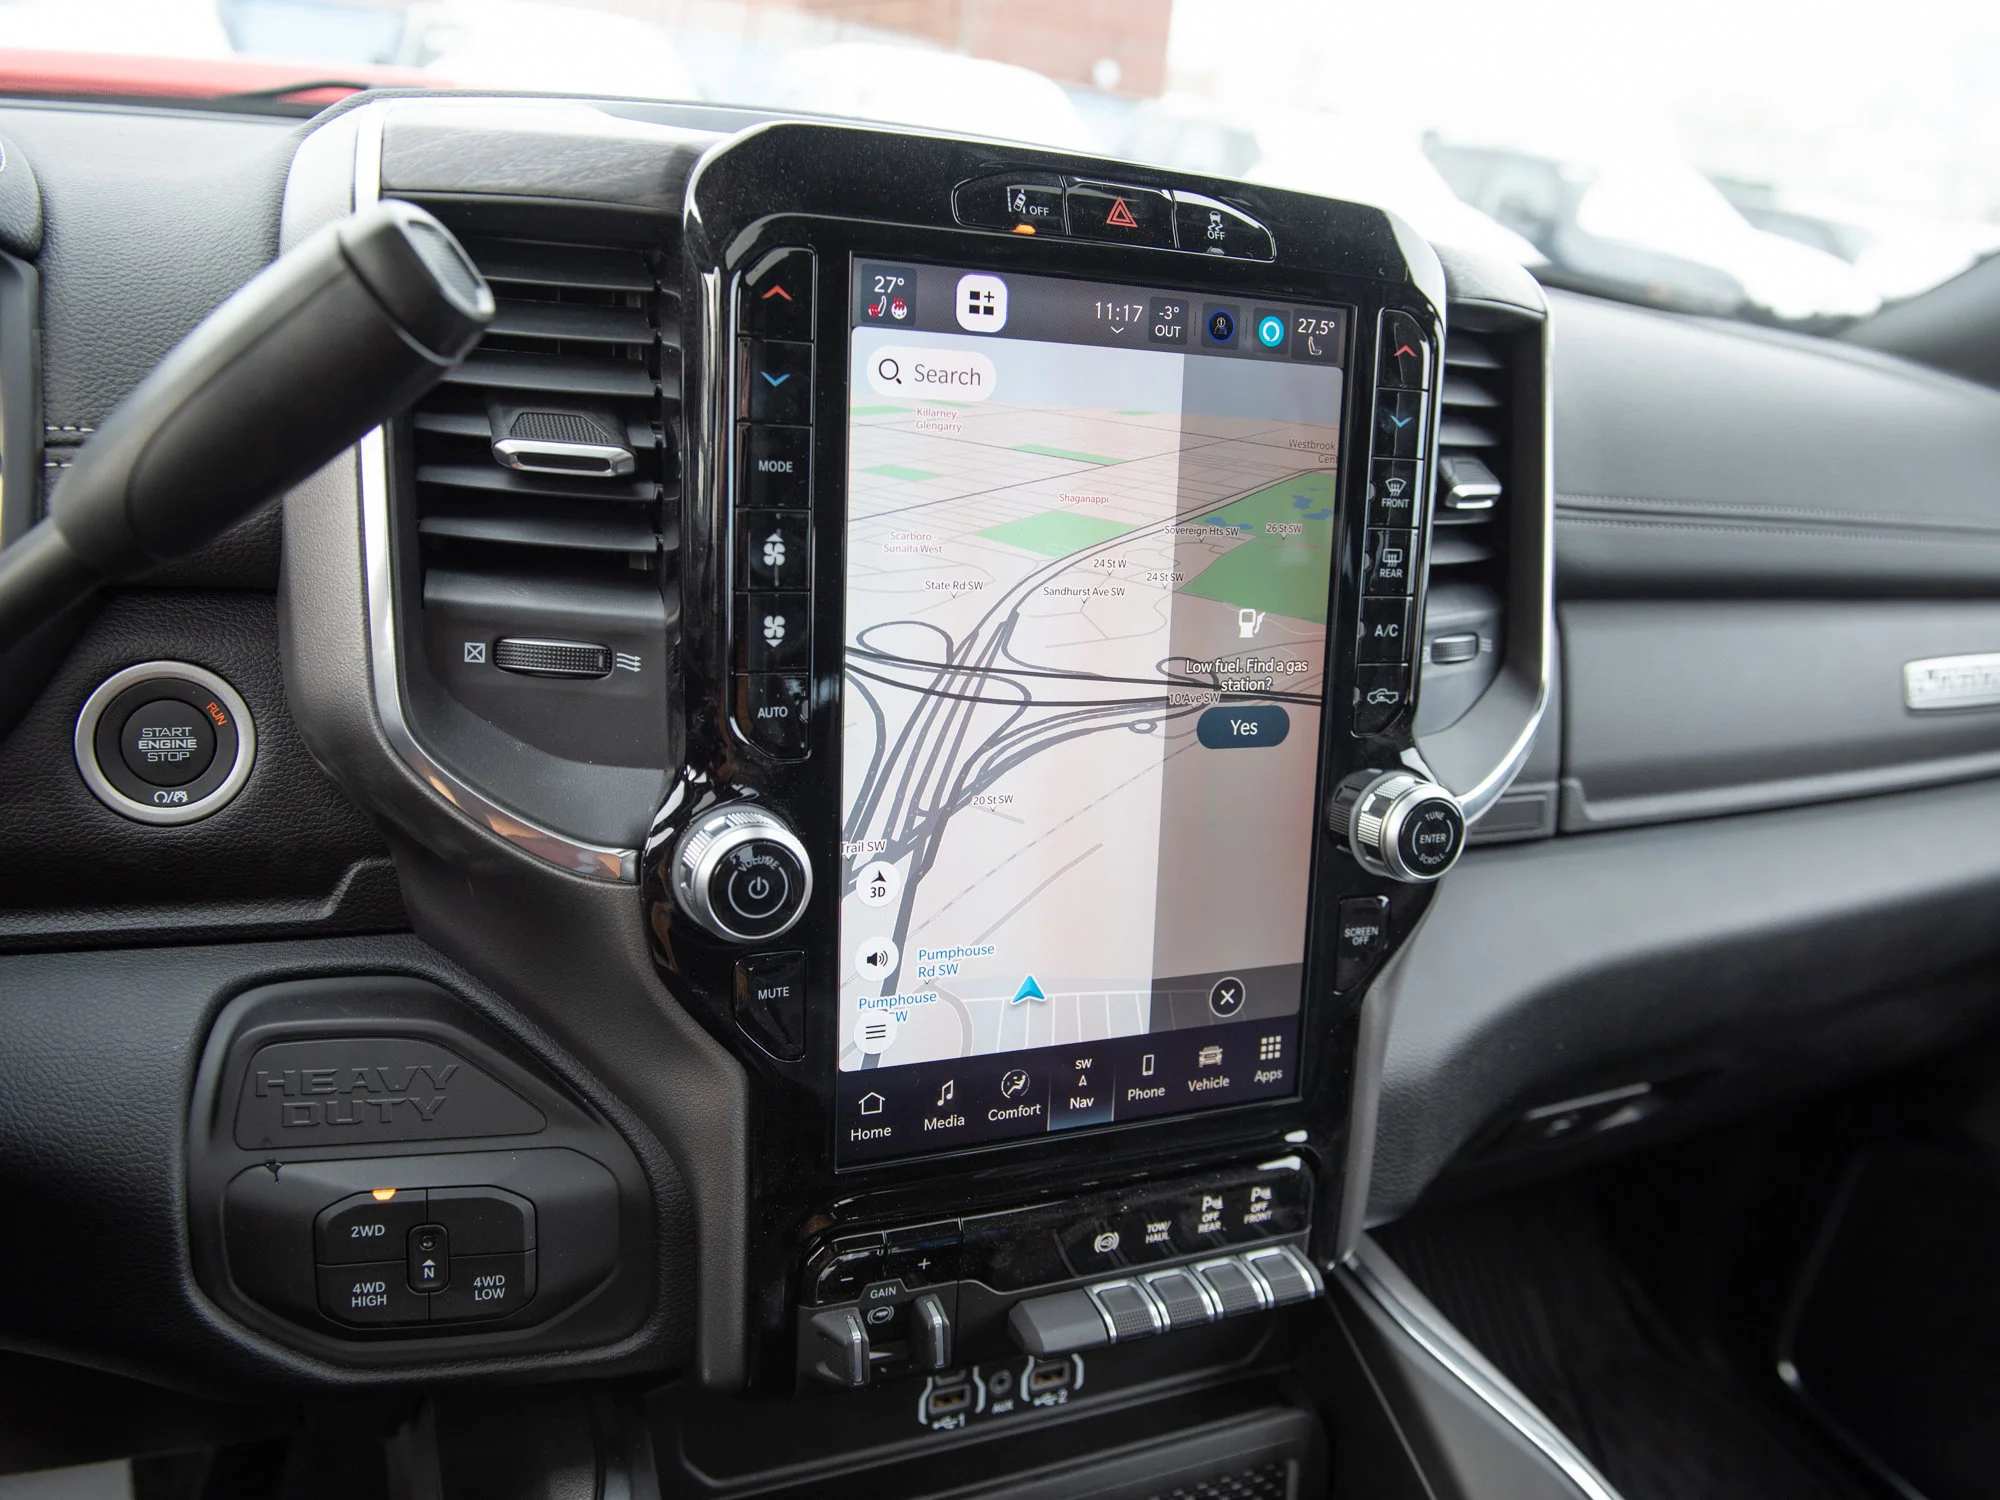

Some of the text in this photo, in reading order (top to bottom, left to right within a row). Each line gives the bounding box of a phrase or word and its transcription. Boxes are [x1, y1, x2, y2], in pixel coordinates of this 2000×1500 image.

[1029, 205, 1049, 216] OFF
[1207, 230, 1225, 241] OFF
[874, 276, 905, 293] 27°
[1095, 302, 1142, 322] 11:17
[1159, 305, 1180, 321] -3°
[1155, 323, 1181, 338] OUT
[1298, 319, 1335, 335] 27.5°
[914, 363, 981, 387] Search
[916, 407, 957, 420] Killarney
[915, 420, 962, 433] Glengarry
[1289, 439, 1336, 451] Westbrook
[758, 460, 793, 473] MODE
[1059, 493, 1109, 505] Shaganappi
[1381, 498, 1409, 509] FRONT
[1164, 525, 1239, 537] Sovereign Hts SW
[1266, 524, 1302, 533] 26 St SW
[890, 531, 932, 541] Scarboro
[883, 543, 943, 553] Sunalta West
[1094, 559, 1127, 568] 24 St W
[1146, 572, 1184, 582] 24 St SW
[1380, 568, 1403, 578] REAR
[925, 580, 984, 590] State Rd SW
[1043, 586, 1125, 597] Sandhurst Ave SW
[1374, 624, 1399, 637] A/C
[1186, 658, 1308, 676] Low fuel. Find a gas
[1221, 677, 1274, 693] station?
[1169, 692, 1220, 705] 10 Ave SW
[205, 702, 227, 726] RUN
[757, 705, 788, 719] AUTO
[142, 727, 192, 737] START
[1230, 719, 1258, 736] Yes
[138, 739, 198, 749] ENGINE
[147, 752, 190, 762] STOP
[973, 795, 1013, 805] 20 St SW
[1425, 811, 1445, 822] TUNE
[1419, 833, 1447, 844] ENTER
[867, 840, 886, 852] SW
[738, 855, 780, 872] VOLUME
[1419, 854, 1445, 865] SCROLL
[870, 886, 886, 898] 3D
[1344, 926, 1379, 938] SCREEN
[1352, 936, 1370, 946] OFF
[918, 944, 995, 963] Pumphouse
[918, 963, 959, 978] Rd SW
[758, 986, 790, 1000] MUTE
[858, 993, 937, 1010] Pumphouse
[889, 1010, 908, 1023] W
[1075, 1058, 1092, 1070] SW
[255, 1063, 460, 1098] HEAVY
[1254, 1067, 1283, 1085] Apps
[1188, 1075, 1230, 1093] Vehicle
[1127, 1085, 1165, 1101] Phone
[1070, 1096, 1094, 1110] Nav
[281, 1096, 448, 1128] DUTY
[988, 1102, 1041, 1122] Comfort
[924, 1114, 965, 1131] Media
[850, 1125, 892, 1142] Home
[1250, 1201, 1269, 1213] OFF
[1201, 1210, 1220, 1223] OFF
[1243, 1210, 1273, 1225] FRONT
[350, 1224, 385, 1239] 2WD
[1146, 1220, 1171, 1233] TOW/
[1197, 1220, 1221, 1234] REAR
[1145, 1232, 1170, 1244] HAUL
[423, 1267, 435, 1279] N
[352, 1281, 386, 1295] 4WD
[473, 1275, 505, 1288] 4WD
[474, 1287, 506, 1301] LOW
[870, 1286, 897, 1299] GAIN
[351, 1294, 387, 1308] HIGH
